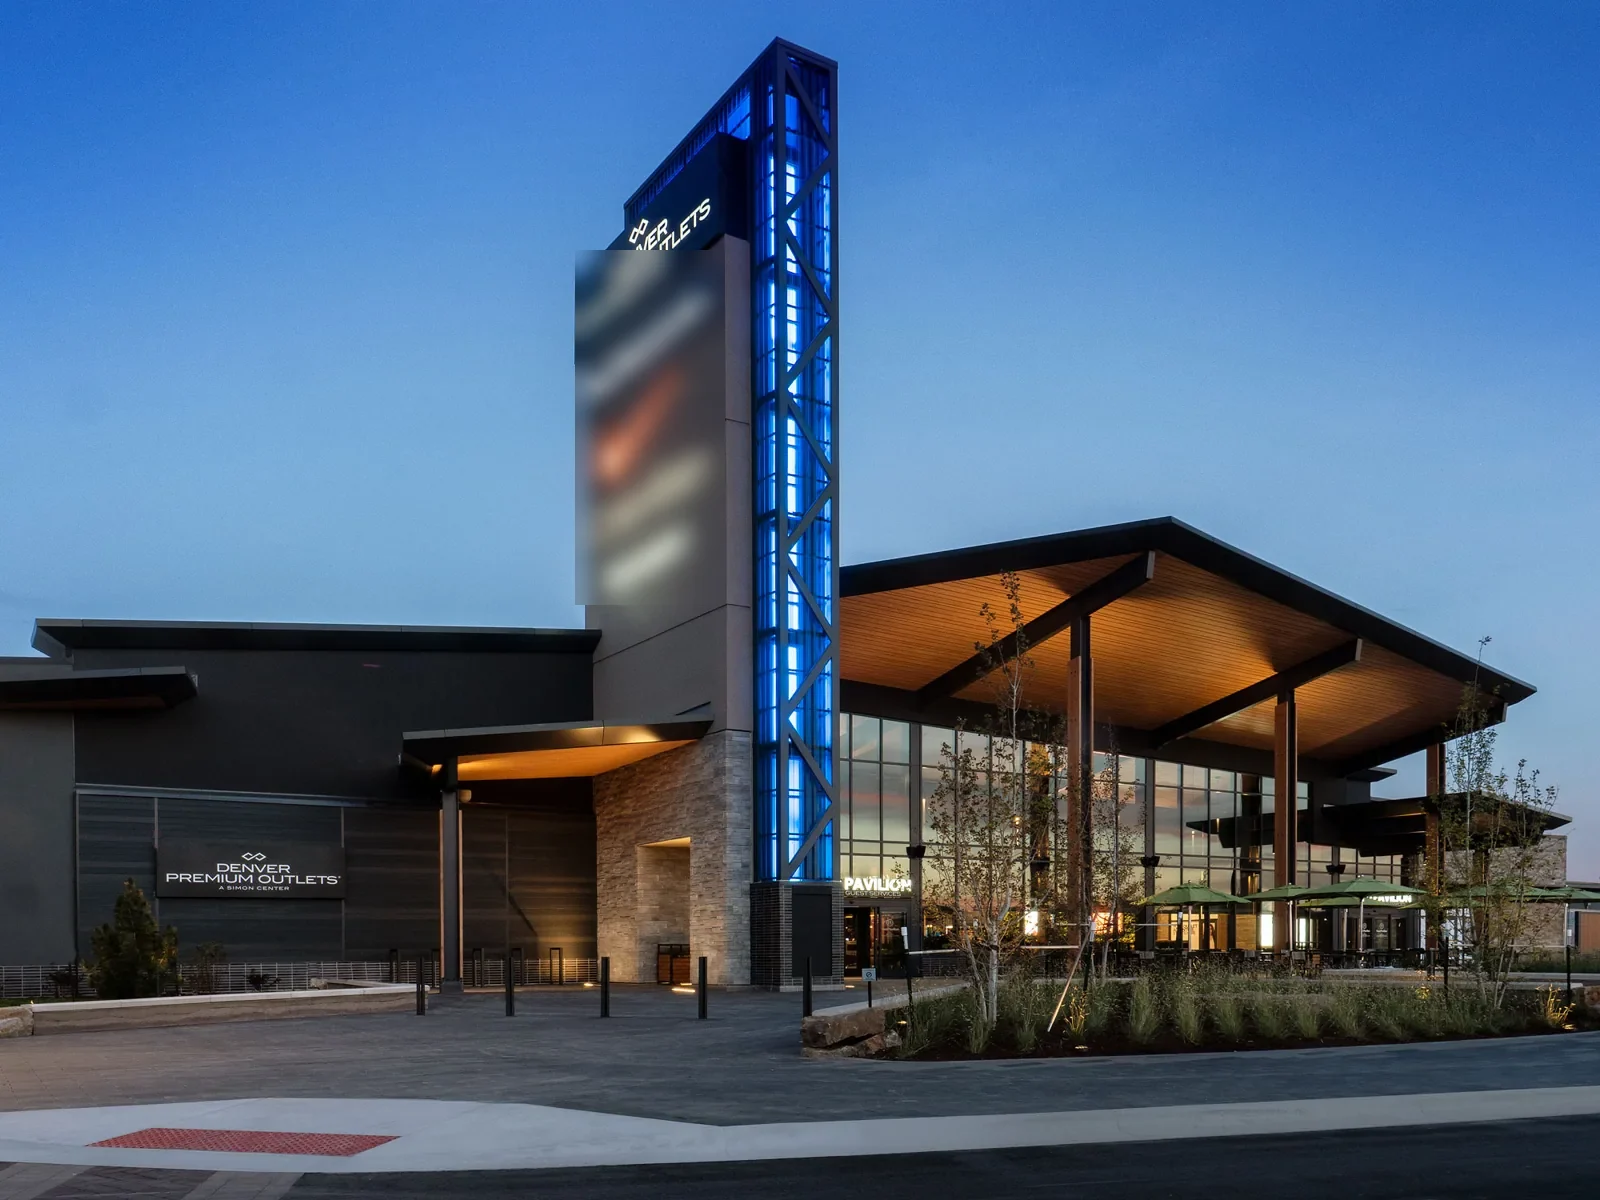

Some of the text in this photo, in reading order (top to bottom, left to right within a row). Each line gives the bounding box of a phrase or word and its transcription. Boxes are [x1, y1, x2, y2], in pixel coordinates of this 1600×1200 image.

[216, 863, 291, 874] DENVER
[166, 873, 338, 885] PREMIUM OUTLETS
[844, 877, 912, 892] PAVILION
